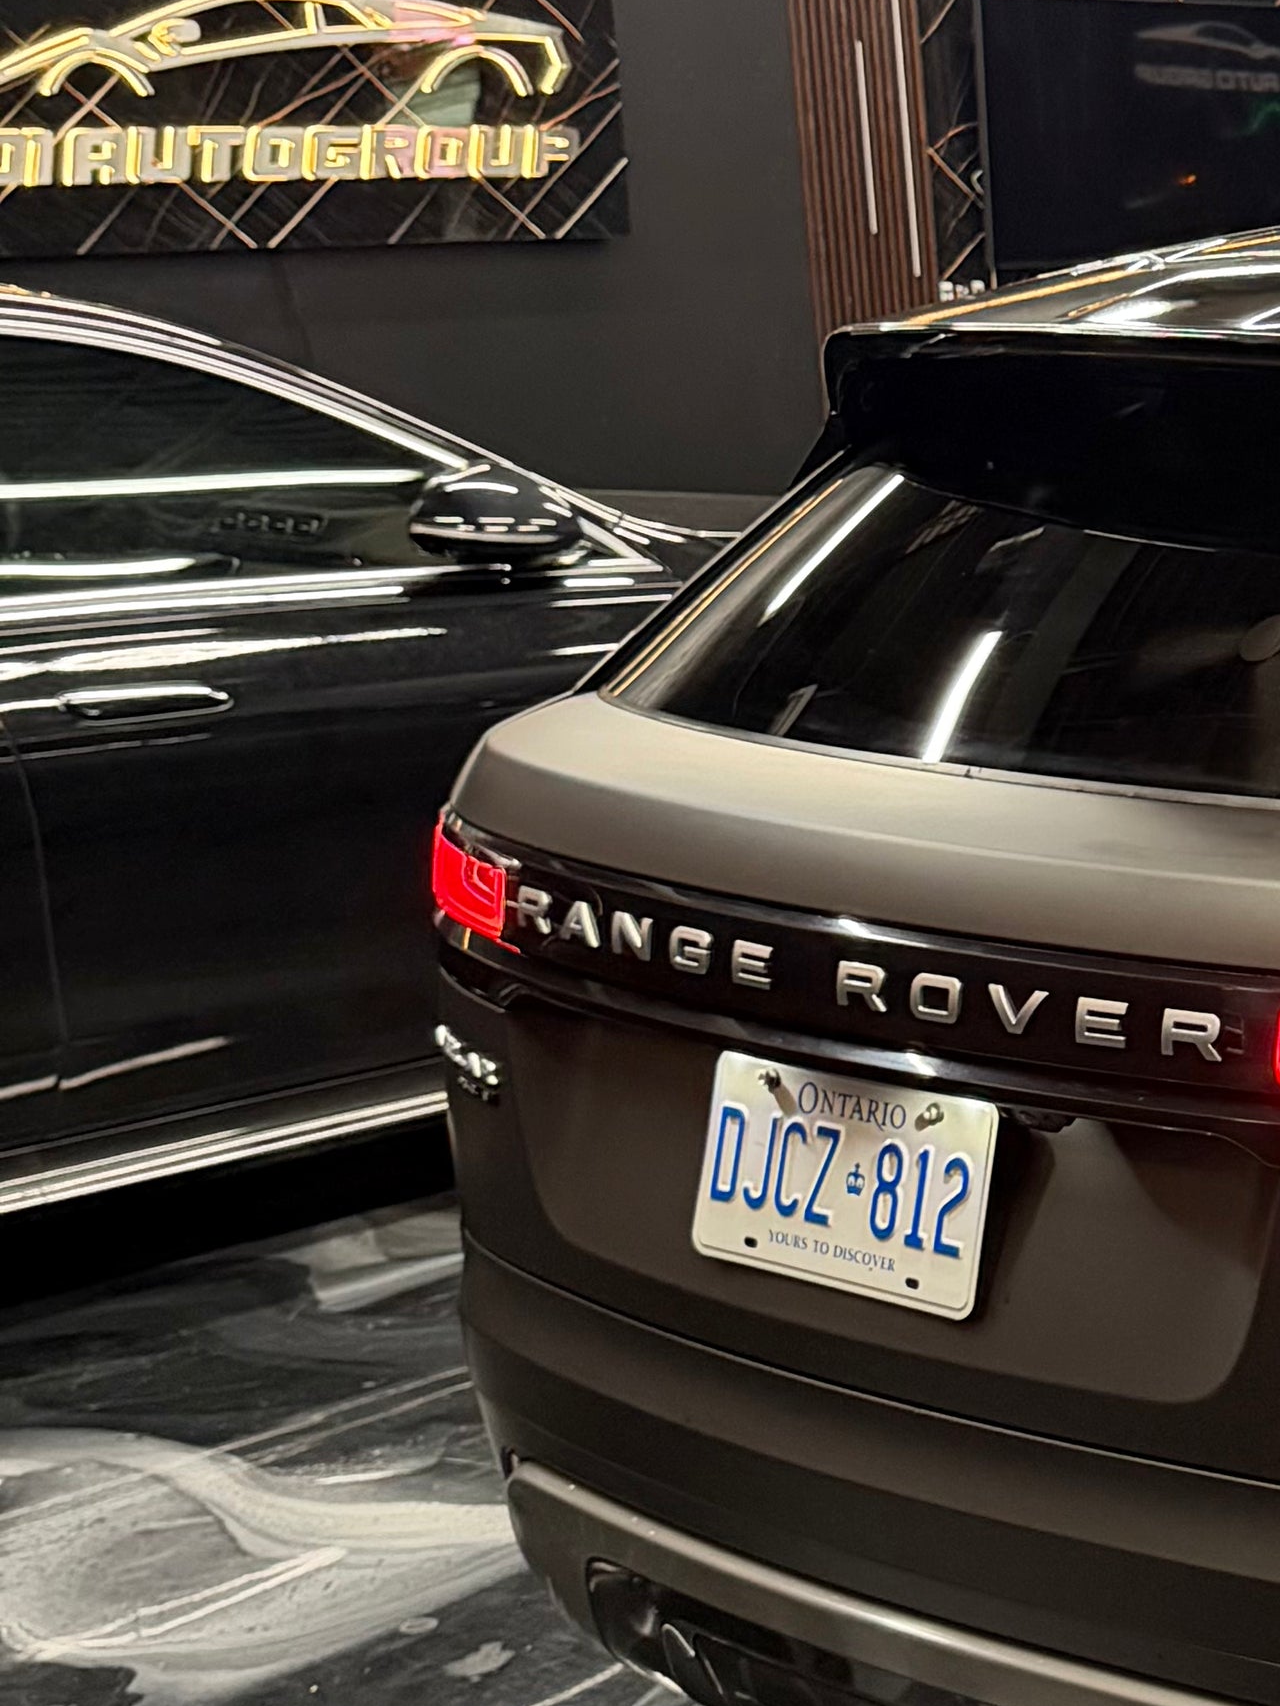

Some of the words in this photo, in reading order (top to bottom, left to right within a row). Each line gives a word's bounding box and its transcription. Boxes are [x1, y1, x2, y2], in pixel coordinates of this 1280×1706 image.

[516, 885, 775, 990] RANGE
[836, 960, 1223, 1063] ROVER
[799, 1082, 907, 1131] ONTARIO
[709, 1105, 842, 1227] DJCZ
[869, 1143, 970, 1259] 812
[768, 1229, 808, 1250] YOURS
[813, 1239, 830, 1255] TO
[833, 1244, 896, 1272] DISCOVER
